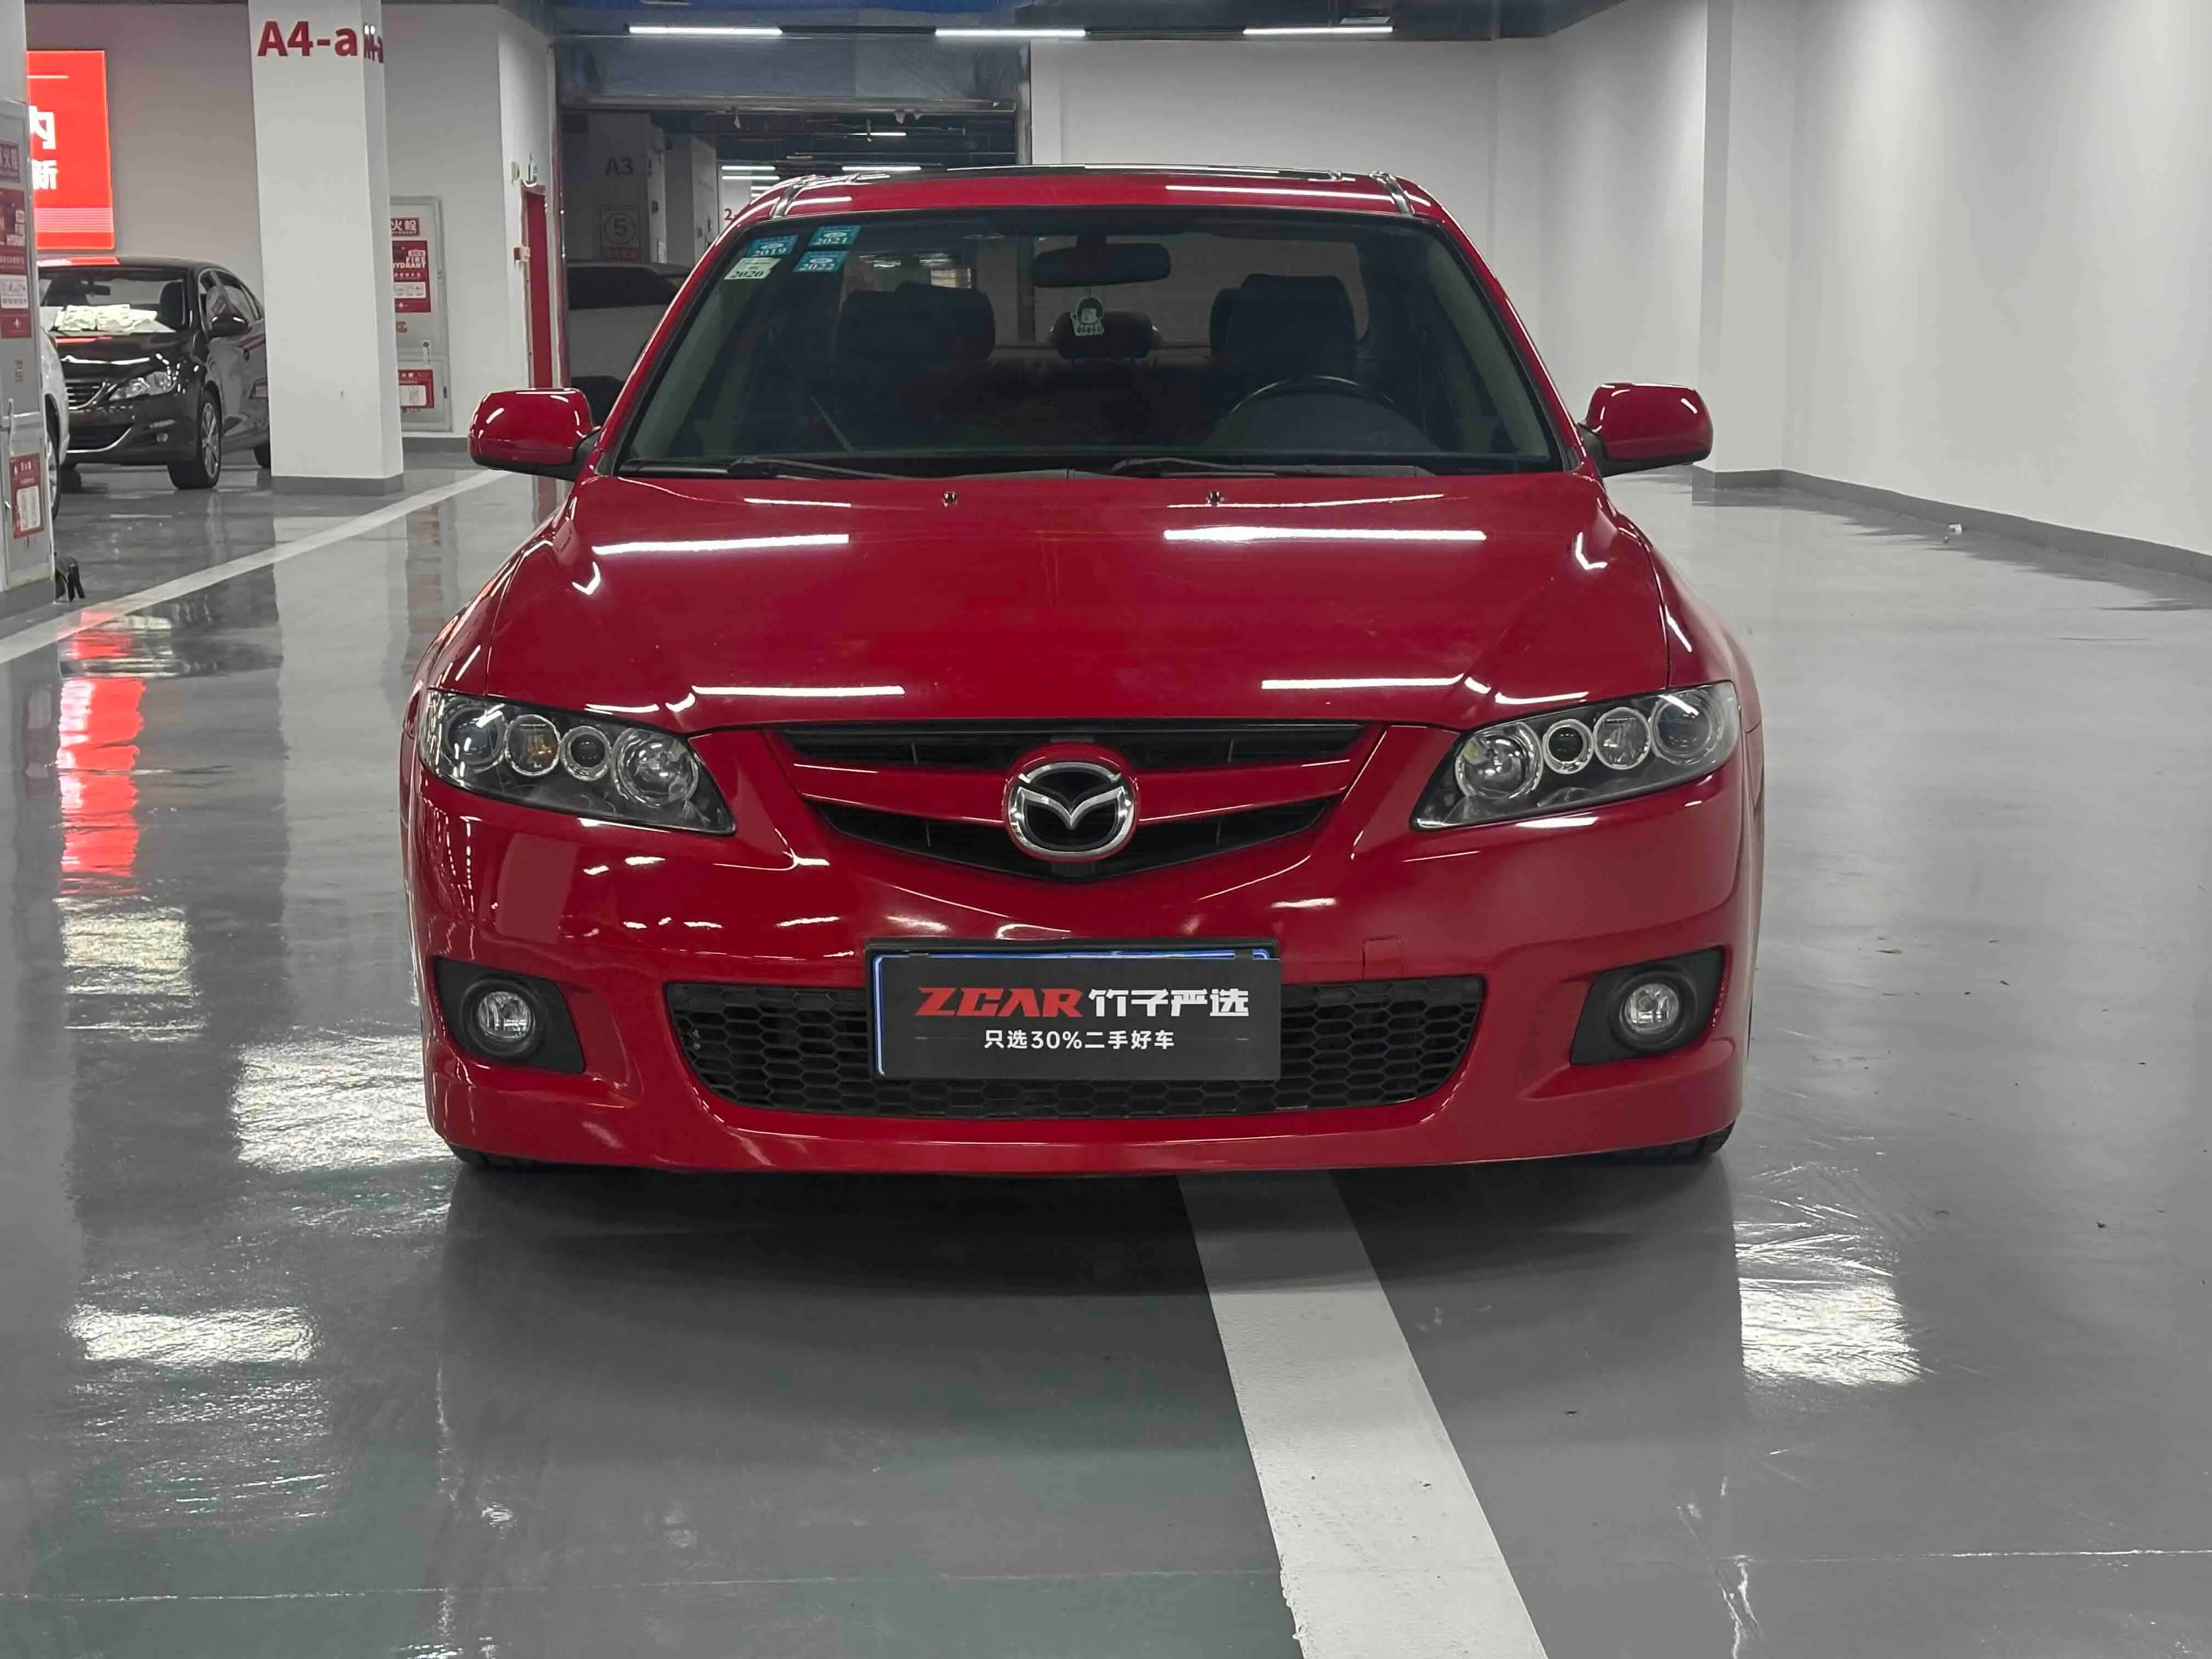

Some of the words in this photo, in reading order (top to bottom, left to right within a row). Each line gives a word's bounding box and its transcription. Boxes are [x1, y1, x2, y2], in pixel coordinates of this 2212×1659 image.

[257, 21, 358, 57] A4-a
[606, 156, 633, 176] A3
[813, 236, 847, 245] 2021
[799, 263, 834, 271] 2022
[1088, 989, 1249, 1017] 竹子严选
[984, 1030, 1175, 1049] 只选30%二手好车
